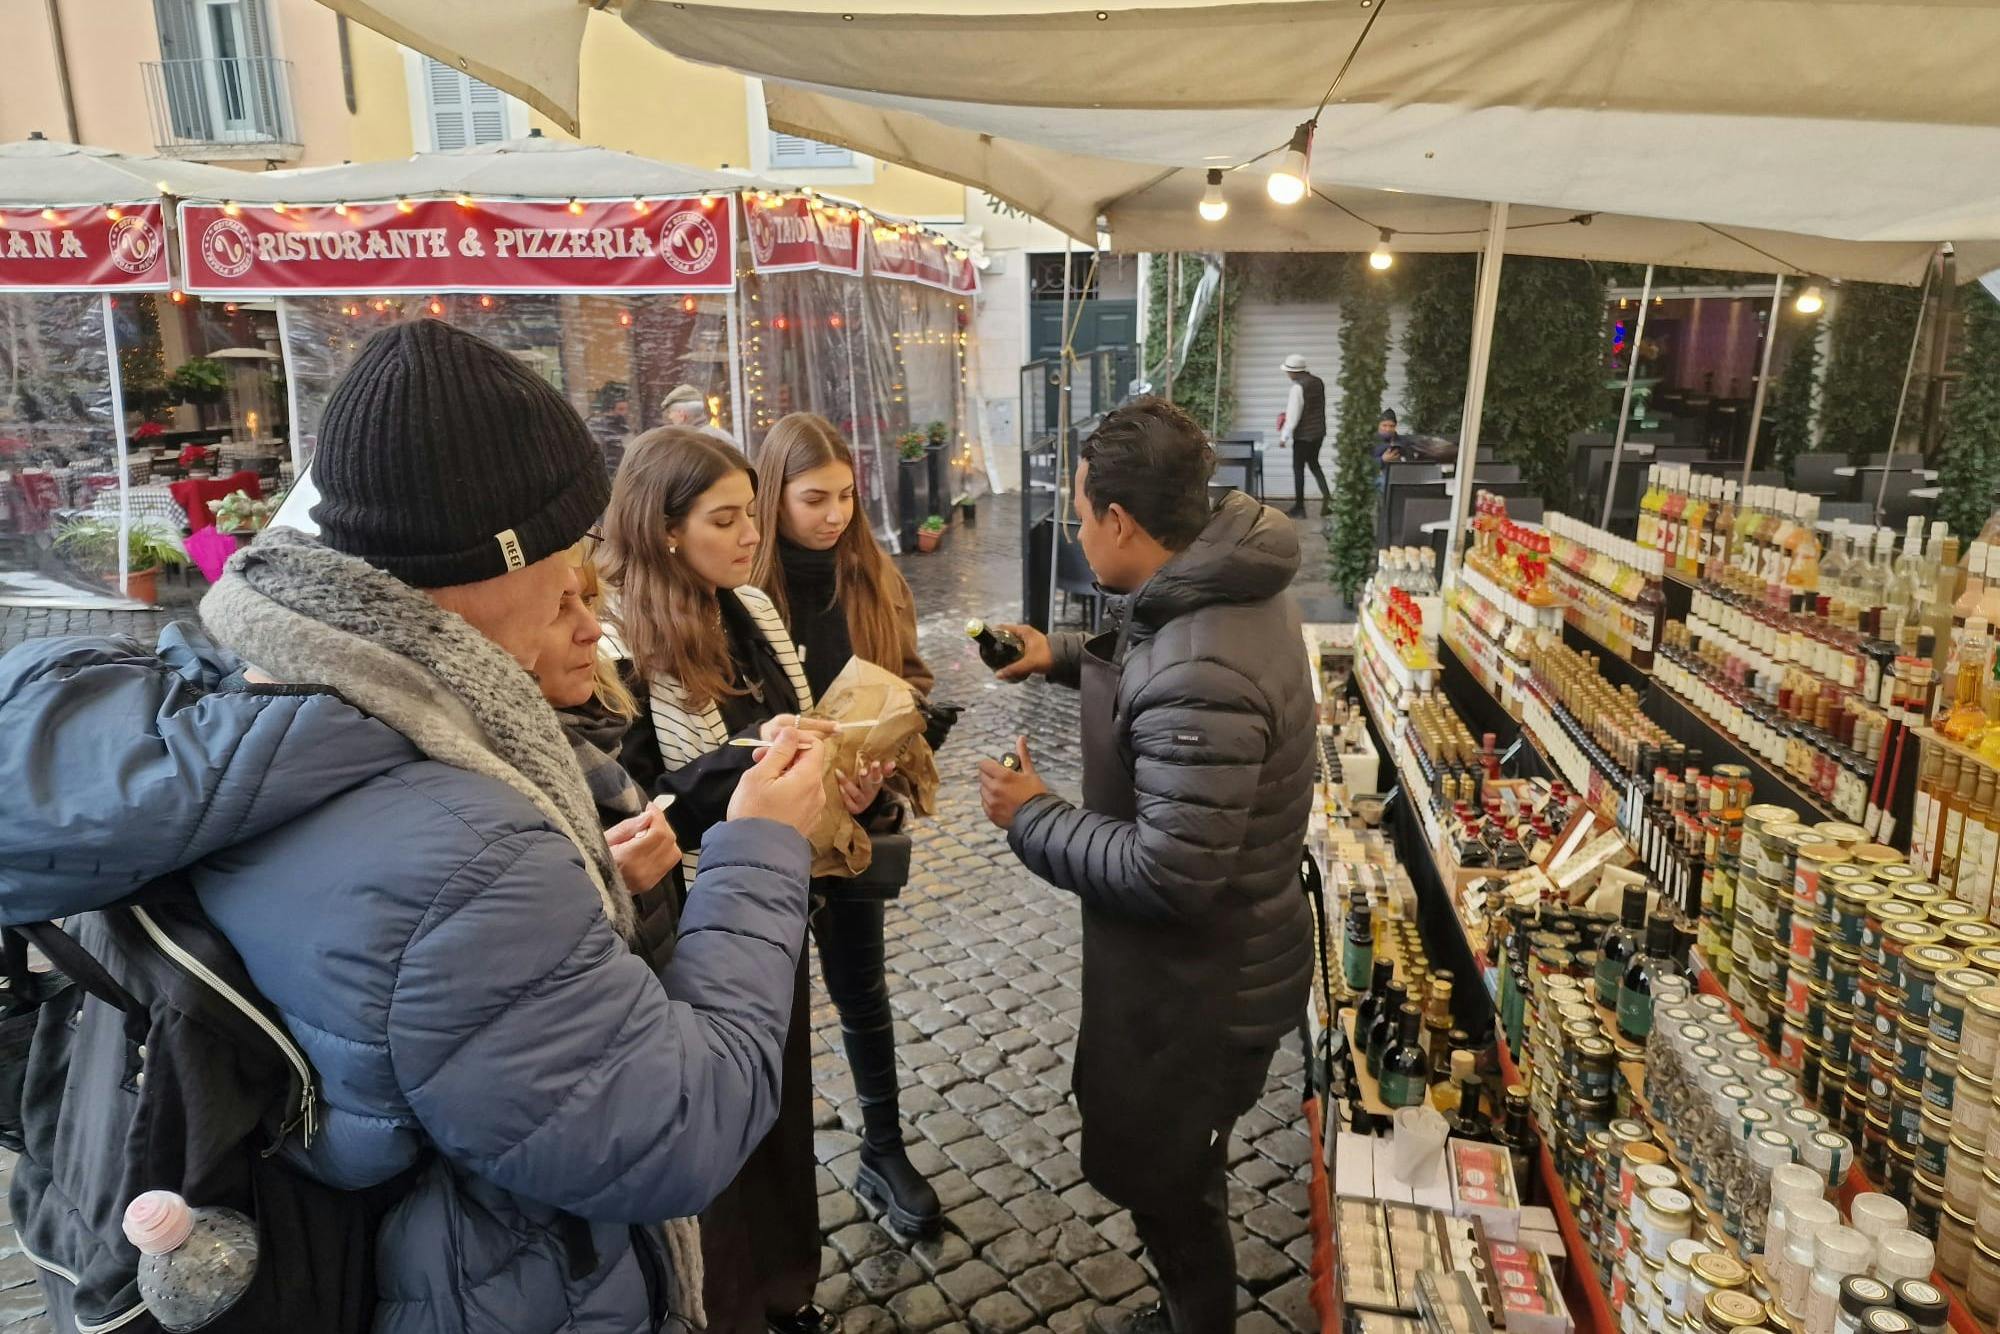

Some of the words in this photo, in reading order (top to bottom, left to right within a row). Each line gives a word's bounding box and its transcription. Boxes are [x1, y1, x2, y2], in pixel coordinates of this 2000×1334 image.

[0, 230, 87, 258] ANA
[257, 227, 450, 262] RISTORANTE
[458, 227, 486, 257] &
[494, 227, 656, 259] PIZZERIA
[505, 540, 522, 567] REEF
